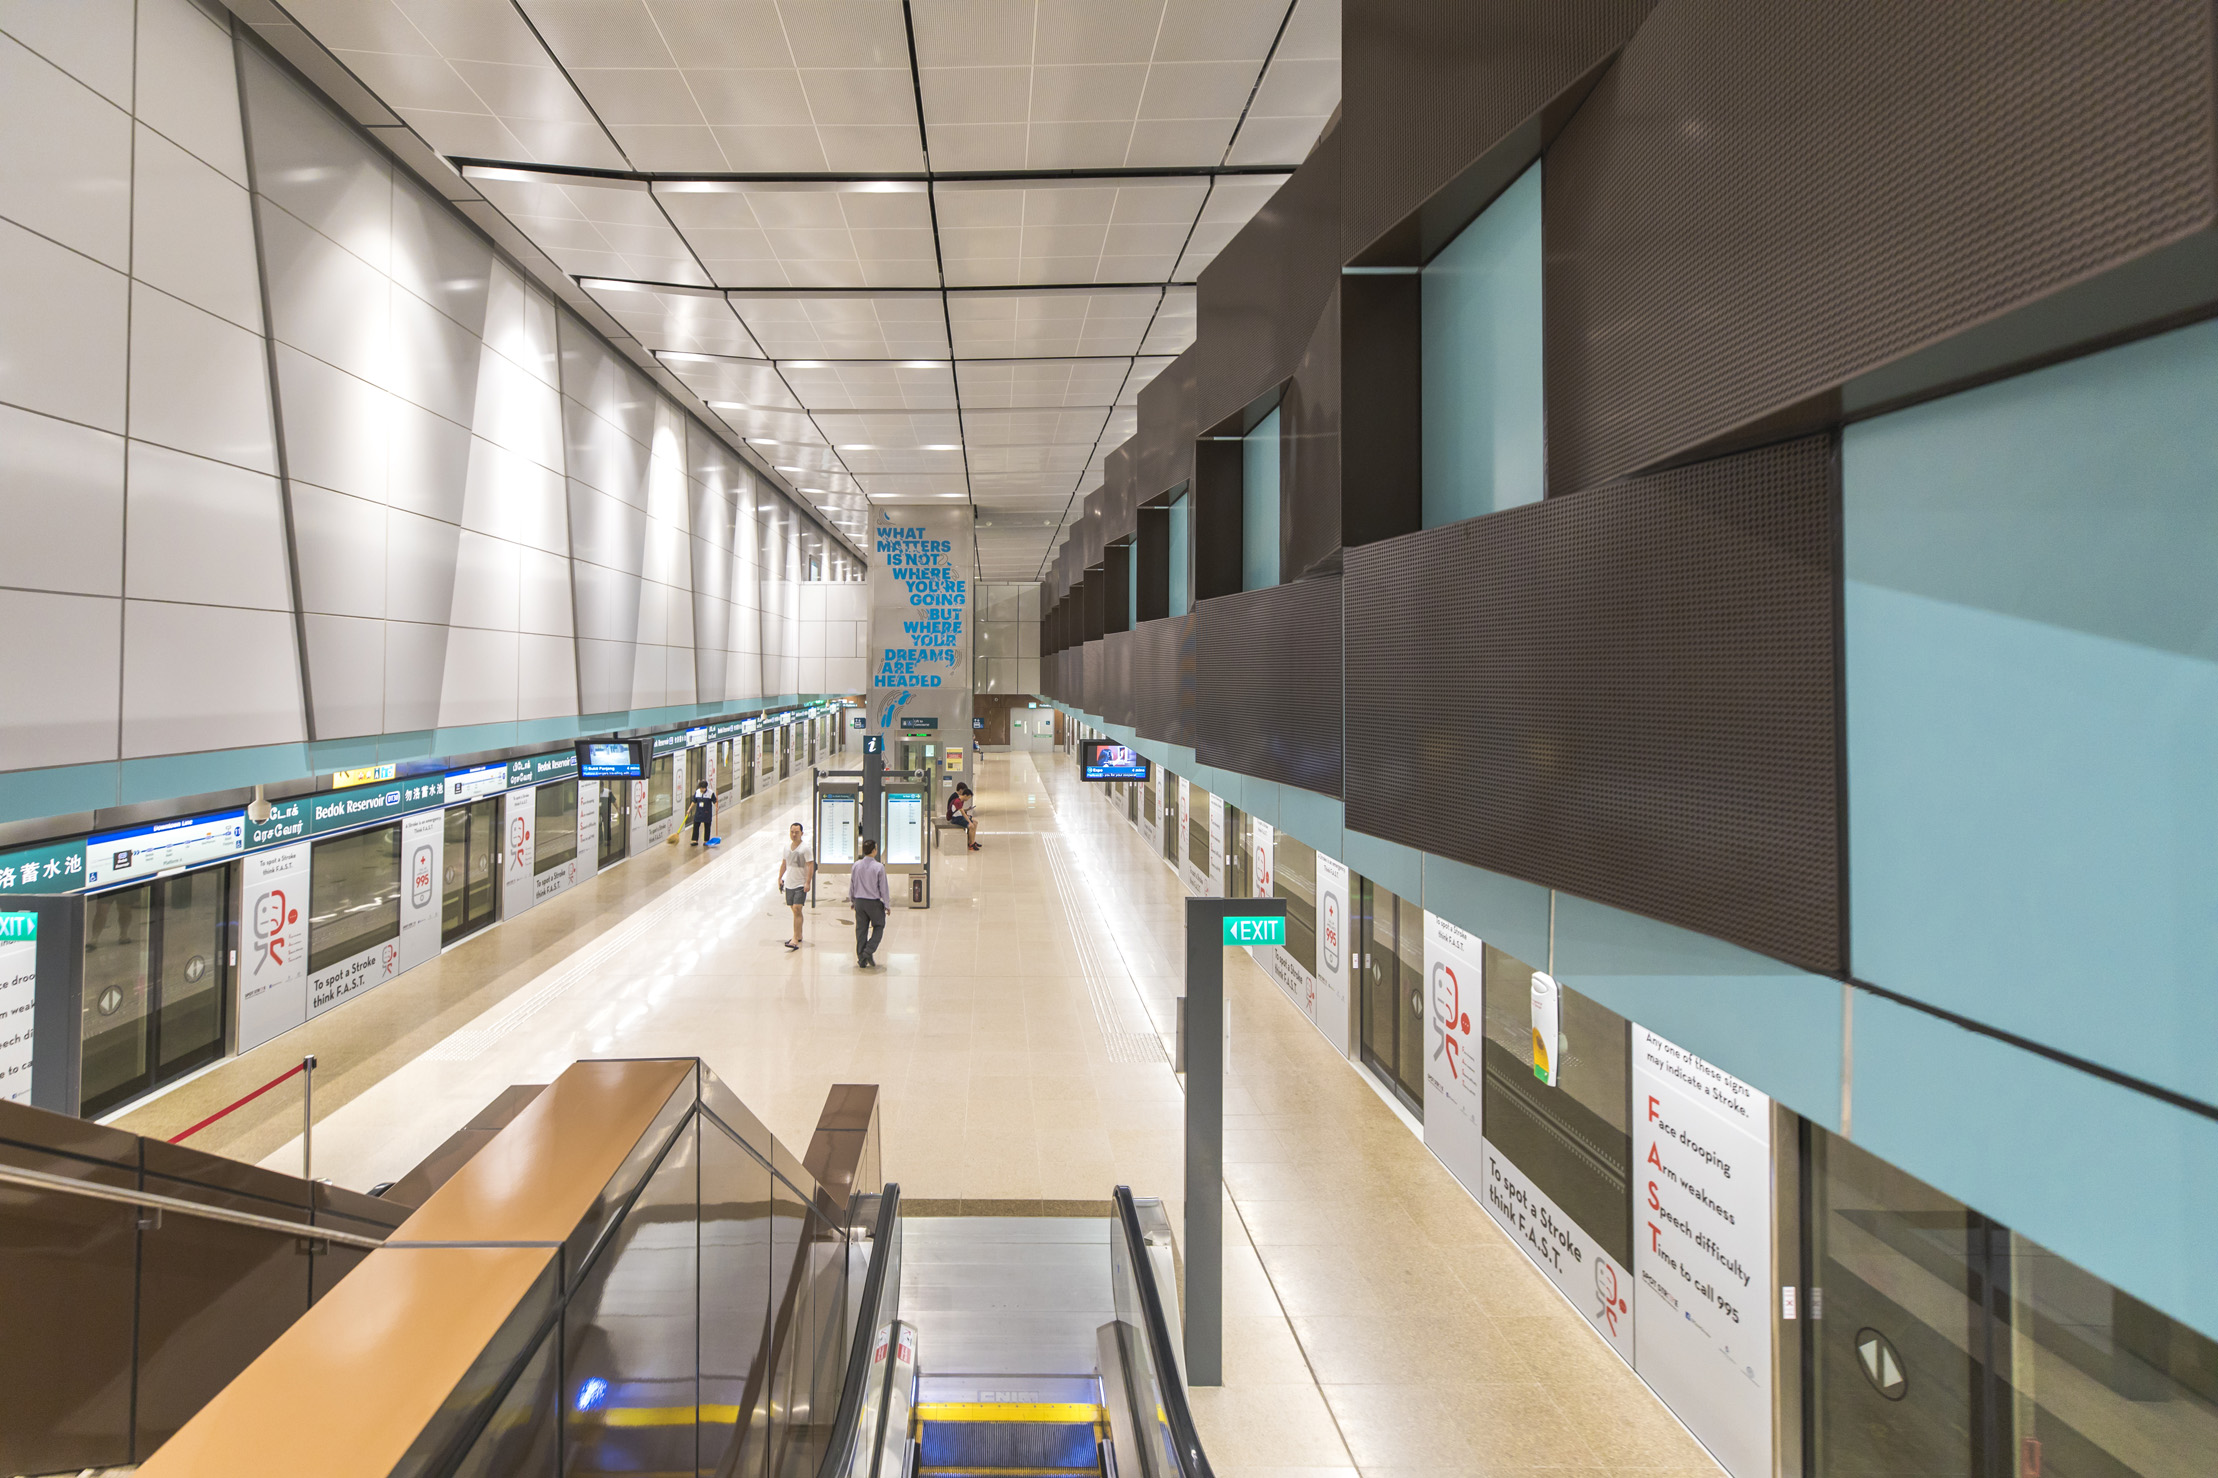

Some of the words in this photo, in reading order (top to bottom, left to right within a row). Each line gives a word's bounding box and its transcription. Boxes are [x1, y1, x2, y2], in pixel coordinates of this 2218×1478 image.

[877, 527, 926, 539] WHAT
[877, 540, 951, 553] MATTERS
[887, 553, 903, 566] IS
[904, 553, 940, 566] NOT
[892, 568, 951, 580] WHERE
[906, 581, 966, 593] YOU'RE
[910, 594, 966, 606] GOING
[928, 608, 962, 620] BUT
[903, 621, 962, 634] WHERE
[911, 634, 957, 647] YOUR
[885, 649, 955, 663] DREAMS
[881, 662, 915, 674] ARE
[875, 675, 942, 687] HEADED
[537, 760, 551, 773] Bedok
[551, 757, 570, 770] Reservoir
[405, 782, 444, 802] 勿洛蓄水池
[315, 803, 345, 821] Bedok
[346, 793, 385, 814] Reservoir
[415, 873, 430, 889] 995
[536, 880, 542, 888] To
[541, 876, 551, 888] spot
[553, 869, 566, 880] Stroke
[535, 888, 546, 900] think
[1240, 920, 1279, 941] EXIT
[1325, 927, 1337, 947] 995
[314, 979, 324, 991] To
[325, 969, 344, 988] spot
[345, 969, 350, 978] a
[351, 955, 376, 974] Stroke
[1274, 947, 1279, 961] To
[1279, 955, 1288, 969] spot
[1290, 963, 1303, 985] Stroke
[1274, 962, 1284, 981] think
[313, 989, 335, 1009] think
[336, 974, 365, 998] F.A.S.T.
[8, 1065, 19, 1075] to
[1646, 1033, 1662, 1051] Any
[1664, 1044, 1681, 1059] one
[1682, 1053, 1693, 1065] of
[1695, 1057, 1721, 1081] these
[1724, 1075, 1750, 1098] signs
[1647, 1053, 1664, 1071] may
[1666, 1060, 1702, 1091] indicate
[1704, 1086, 1710, 1095] a
[1712, 1087, 1749, 1118] Stroke.
[1648, 1094, 1677, 1138] Face
[1679, 1130, 1731, 1179] drooping
[1647, 1140, 1677, 1182] Arm
[1680, 1177, 1735, 1226] weakness
[1489, 1156, 1501, 1182] To
[1503, 1177, 1528, 1210] spot
[1530, 1204, 1537, 1219] a
[1540, 1207, 1582, 1263] Stroke
[1489, 1184, 1516, 1226] think
[1519, 1212, 1563, 1274] F.A.S.T.
[1648, 1180, 1692, 1239] Speech
[1695, 1231, 1751, 1287] difficulty
[1647, 1221, 1677, 1271] Time
[1680, 1262, 1692, 1282] to
[1694, 1280, 1714, 1303] call
[1716, 1295, 1740, 1324] 995
